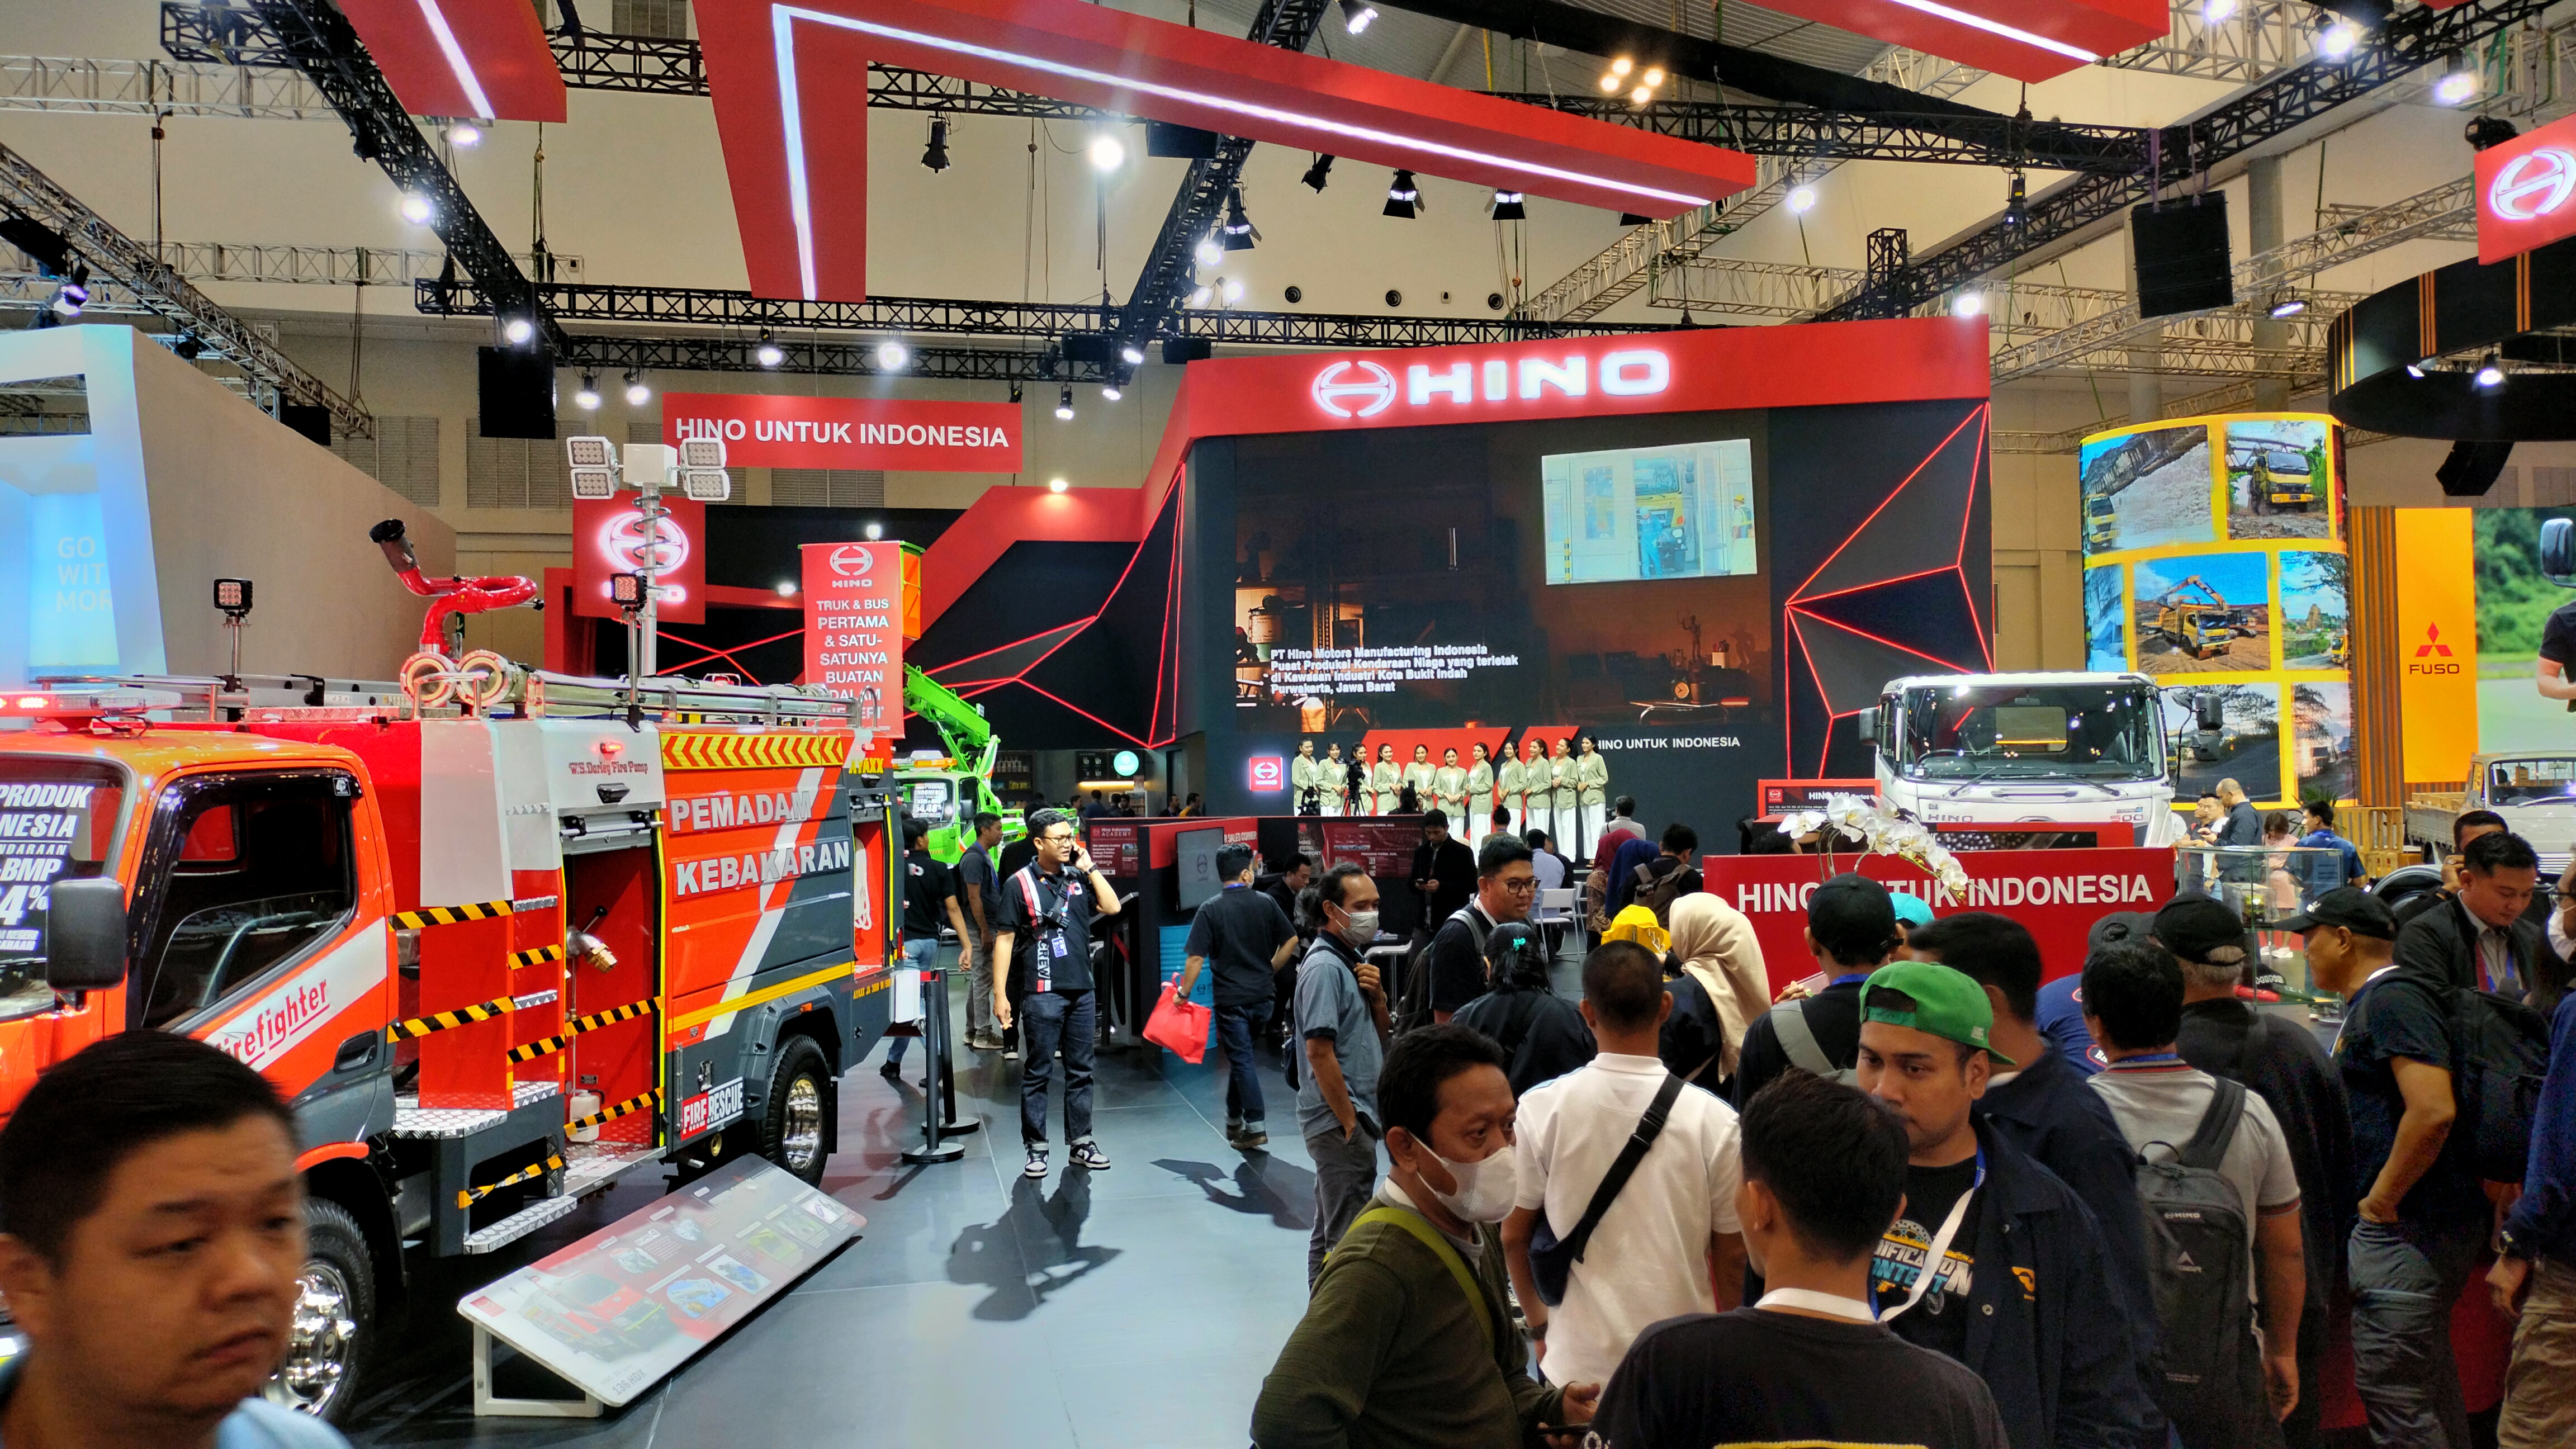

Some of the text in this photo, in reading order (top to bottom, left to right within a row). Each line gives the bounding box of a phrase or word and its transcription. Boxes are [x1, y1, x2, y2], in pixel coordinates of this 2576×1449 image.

[1408, 350, 1670, 405] HINO
[676, 418, 1009, 447] HINO UNTUK INDONESIA
[58, 536, 96, 558] GO
[58, 563, 106, 585] WIT
[832, 579, 873, 588] HINO
[56, 589, 112, 612] MOR
[816, 599, 889, 611] TRUK & BUS
[817, 615, 889, 630] PERTAMA
[824, 634, 883, 647] & SATU-
[820, 652, 888, 666] SATUNYA
[1271, 643, 1488, 660] PT Hino Motors Manufacturing Indonesia
[1271, 654, 1519, 671] Pusat Produksi Kendaraan Niaga yang terletak
[2409, 664, 2460, 675] FUSO
[826, 670, 883, 684] BUATAN
[1271, 667, 1468, 683] di Kawasan Industri Kota Bukit Indah
[1271, 681, 1396, 695] Purwakarta, Jawa Barat
[1626, 738, 1668, 749] UNTUK
[1673, 737, 1741, 748] INDONESIA
[612, 761, 627, 774] Fire
[628, 761, 648, 774] Pump
[849, 757, 884, 774] AYAXX
[0, 784, 94, 808] PRODUK
[670, 791, 812, 832] PEMADAM
[1928, 814, 1973, 822] HINO
[1228, 833, 1241, 843] SALES
[1241, 831, 1257, 841] CORNER
[0, 858, 61, 882] BMP
[676, 841, 849, 896] KEBAKARAN
[1880, 879, 1958, 908] TUK
[1967, 874, 2154, 907] INDONESIA
[0, 940, 36, 950] AHAAN
[1038, 940, 1050, 978] CREW
[2256, 974, 2284, 984] HINO
[216, 979, 327, 1061] irefighter
[684, 1082, 743, 1129] FIRE RESCUE
[612, 1368, 647, 1395] 136 HDX
